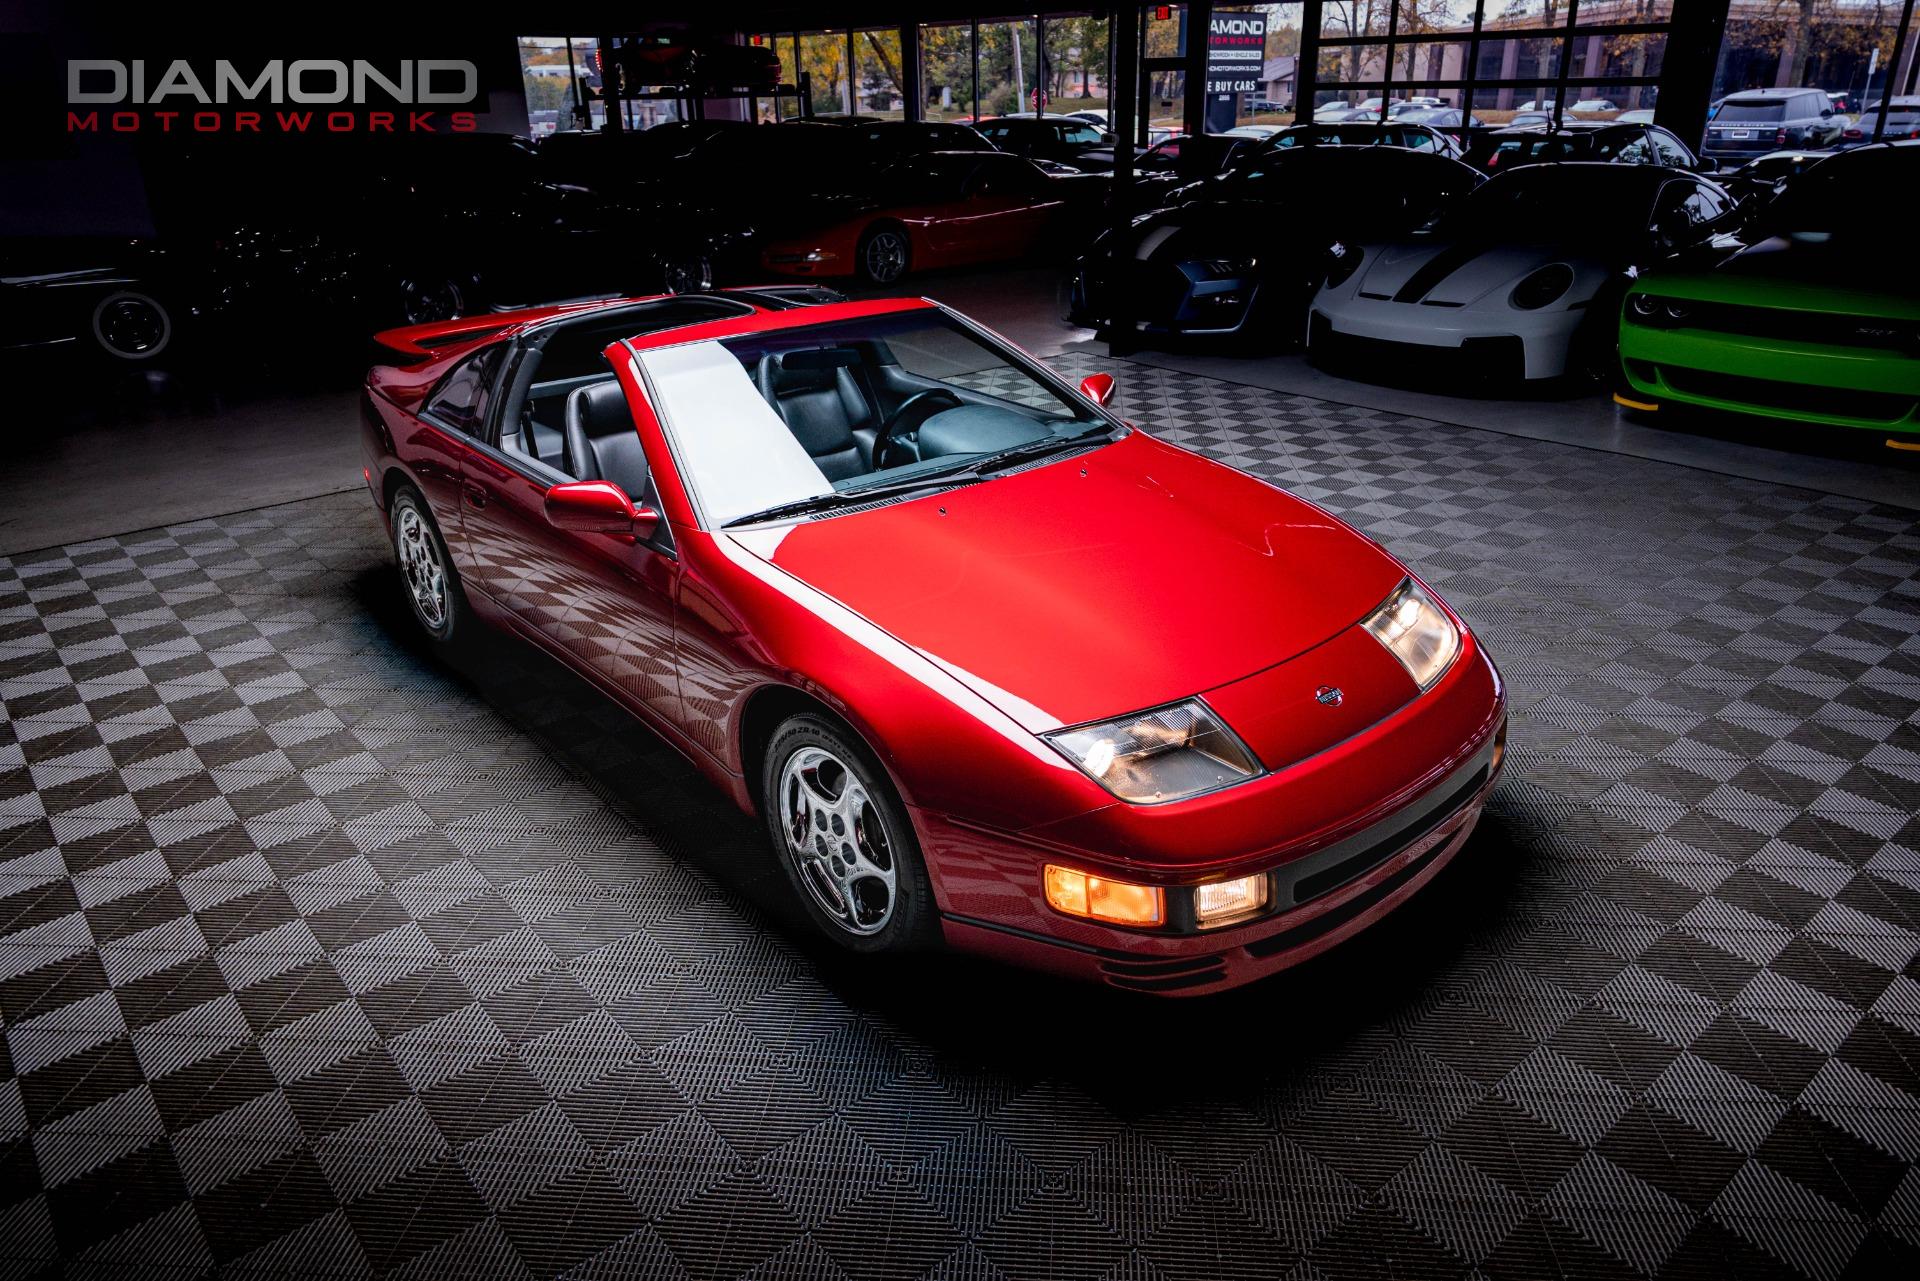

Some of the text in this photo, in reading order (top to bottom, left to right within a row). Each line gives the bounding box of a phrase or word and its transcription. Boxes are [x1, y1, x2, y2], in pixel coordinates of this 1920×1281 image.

[1210, 20, 1263, 34] AMOND
[1215, 81, 1232, 92] BUY
[1234, 81, 1255, 91] CARS
